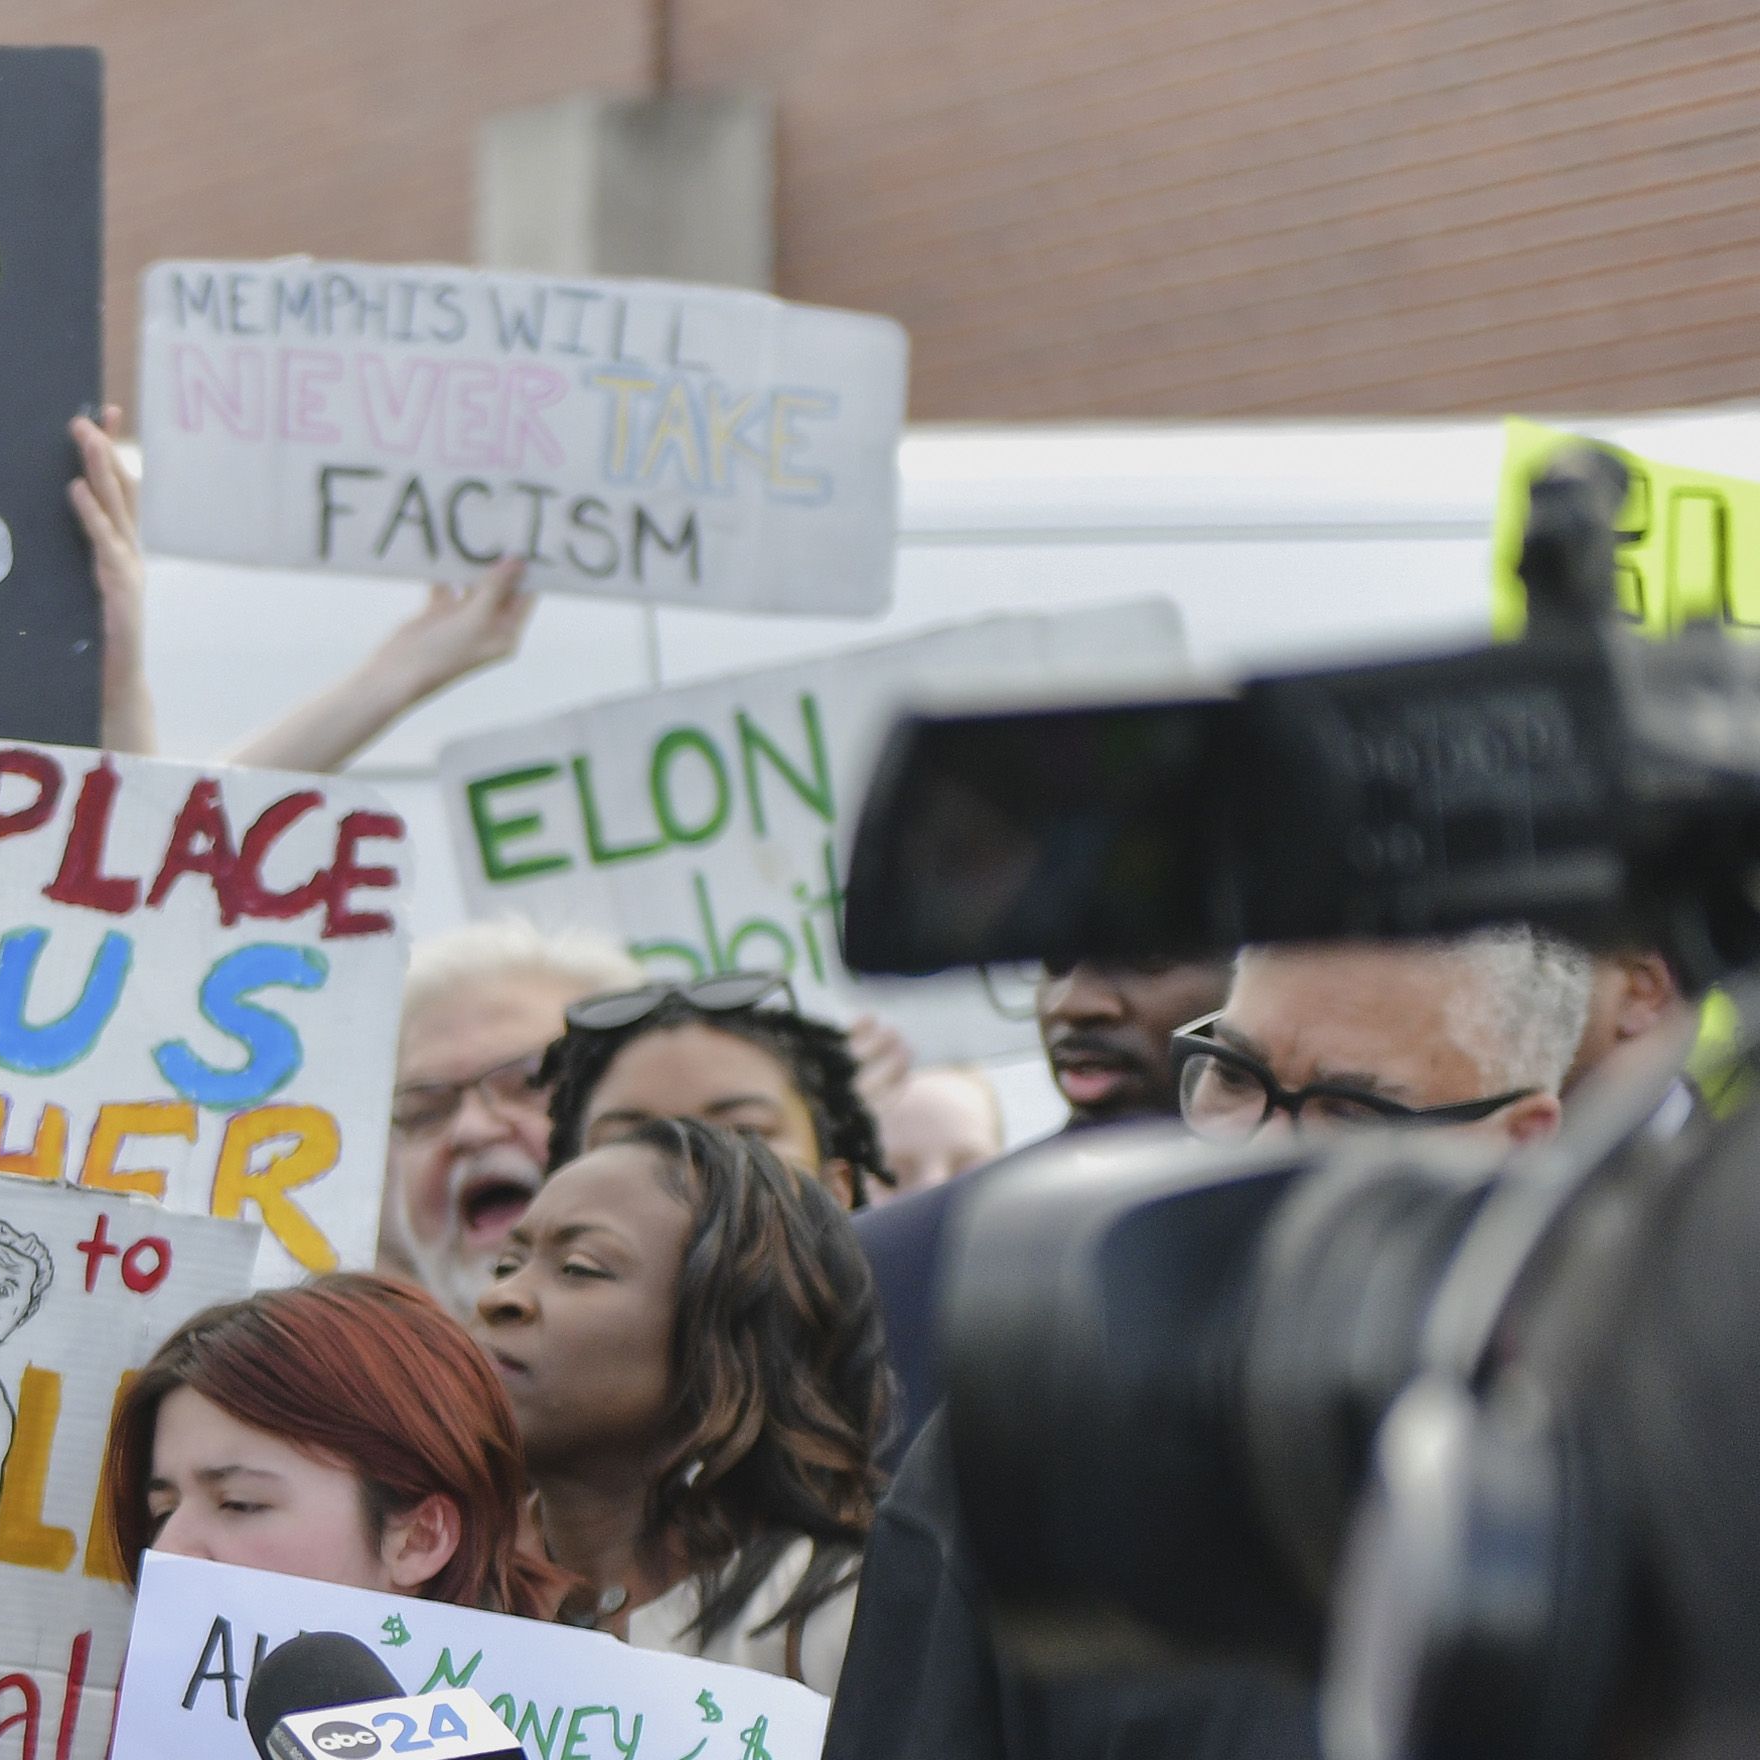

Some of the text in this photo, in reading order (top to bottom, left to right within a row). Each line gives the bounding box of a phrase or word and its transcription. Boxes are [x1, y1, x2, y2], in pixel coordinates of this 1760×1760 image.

[171, 274, 709, 371] MEMPHIS WILL
[171, 344, 840, 507] NEVER TAKE
[315, 463, 702, 584] FACISM
[468, 692, 837, 883] ELON
[77, 1214, 171, 1294] to
[372, 1703, 468, 1753] 24
